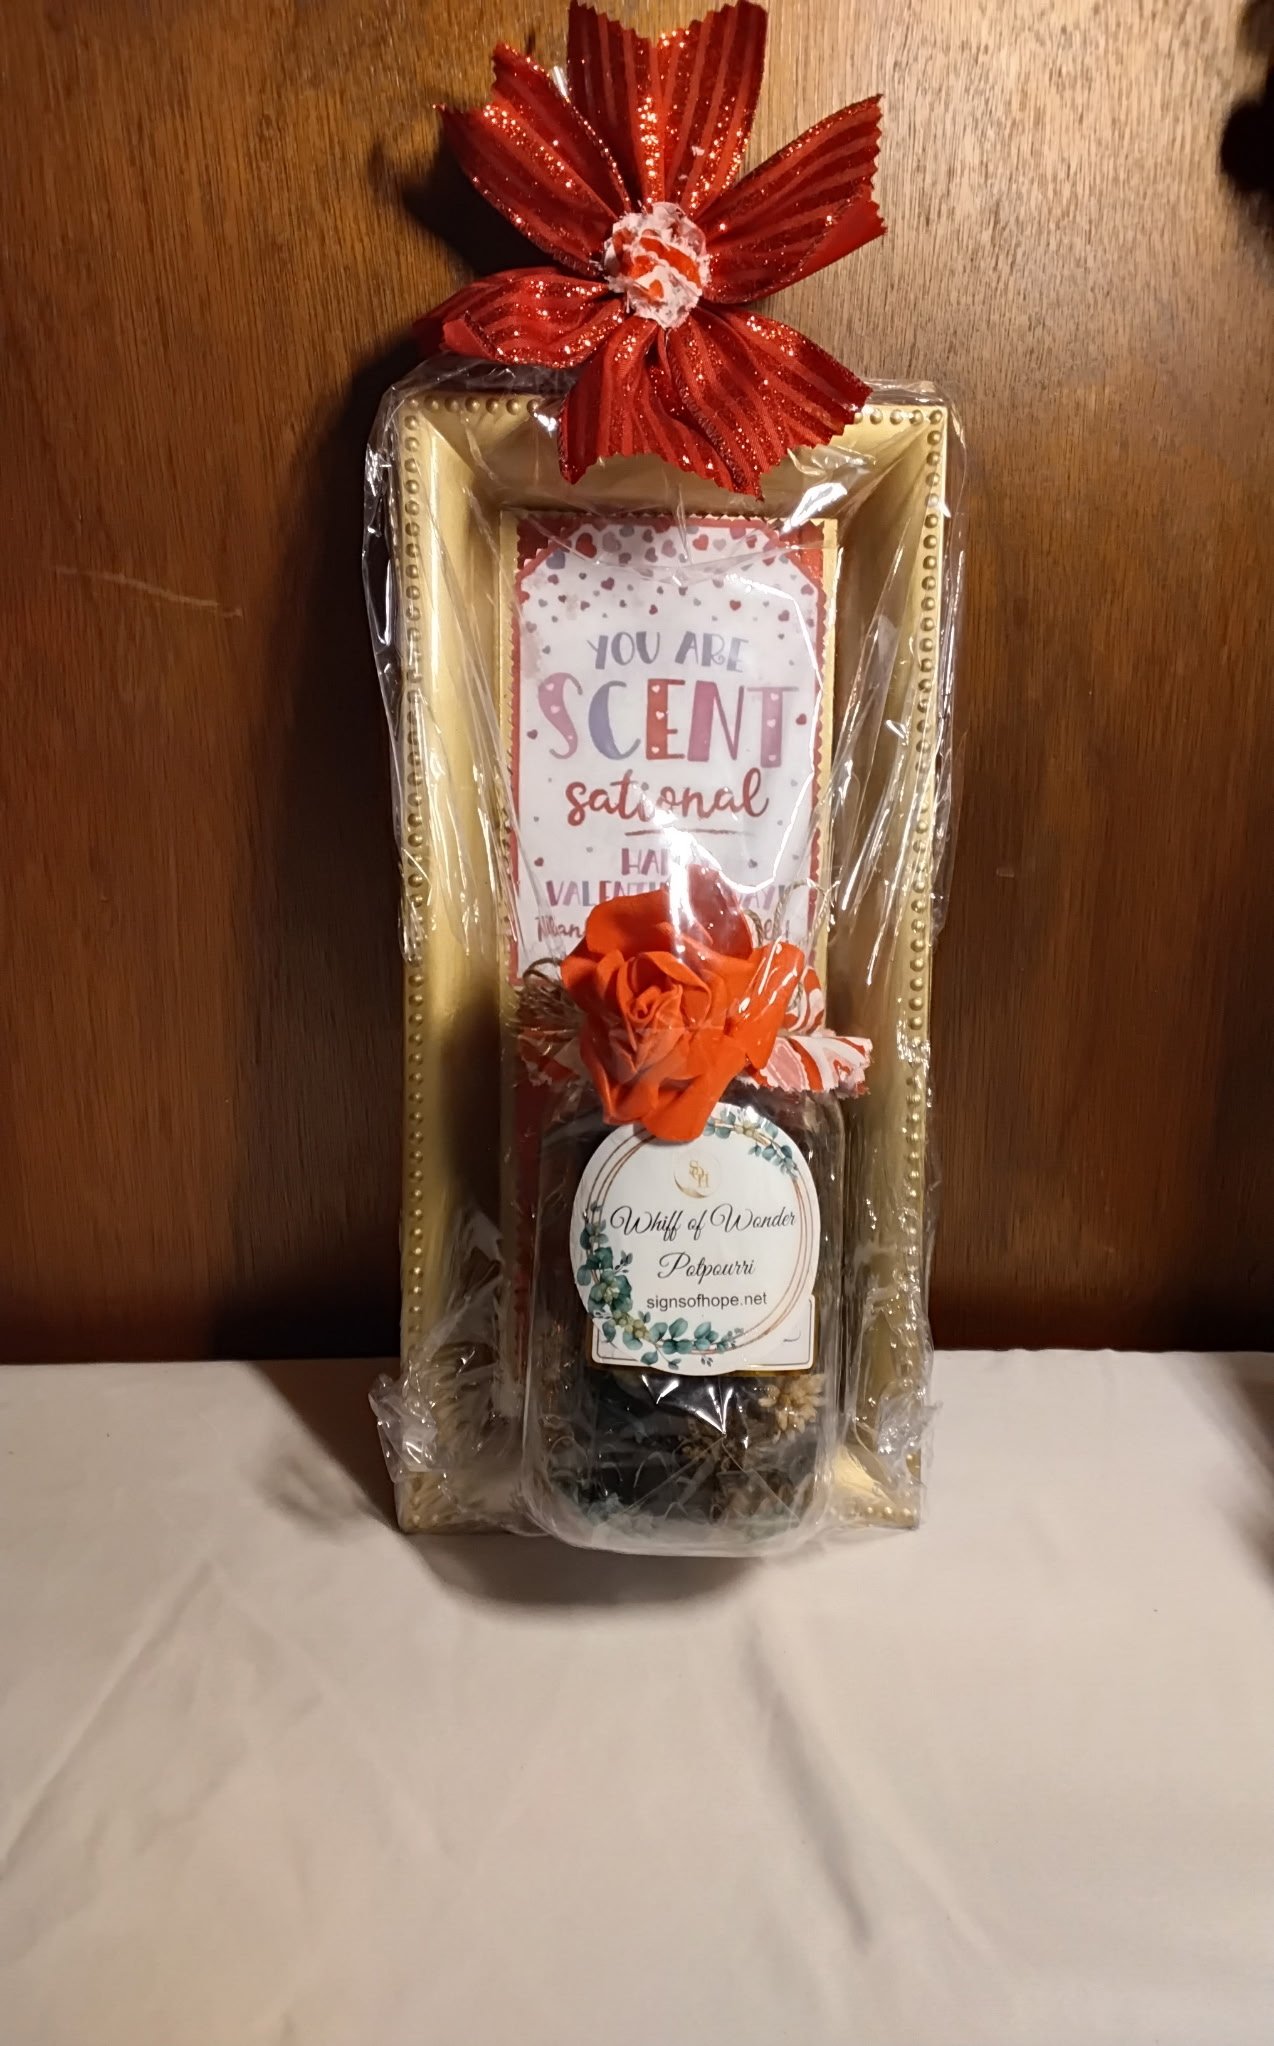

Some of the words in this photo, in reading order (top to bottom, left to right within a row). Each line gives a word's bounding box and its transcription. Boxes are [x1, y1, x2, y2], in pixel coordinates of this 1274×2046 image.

[587, 631, 660, 670] YOU
[674, 631, 748, 673] ARE
[537, 671, 798, 768] SCENT
[565, 768, 769, 826] sational
[609, 1205, 683, 1241] Whiff
[687, 1209, 707, 1240] of
[710, 1203, 796, 1233] Wonder
[657, 1251, 755, 1284] Potpourri
[646, 1292, 767, 1312] signsofhope.net
